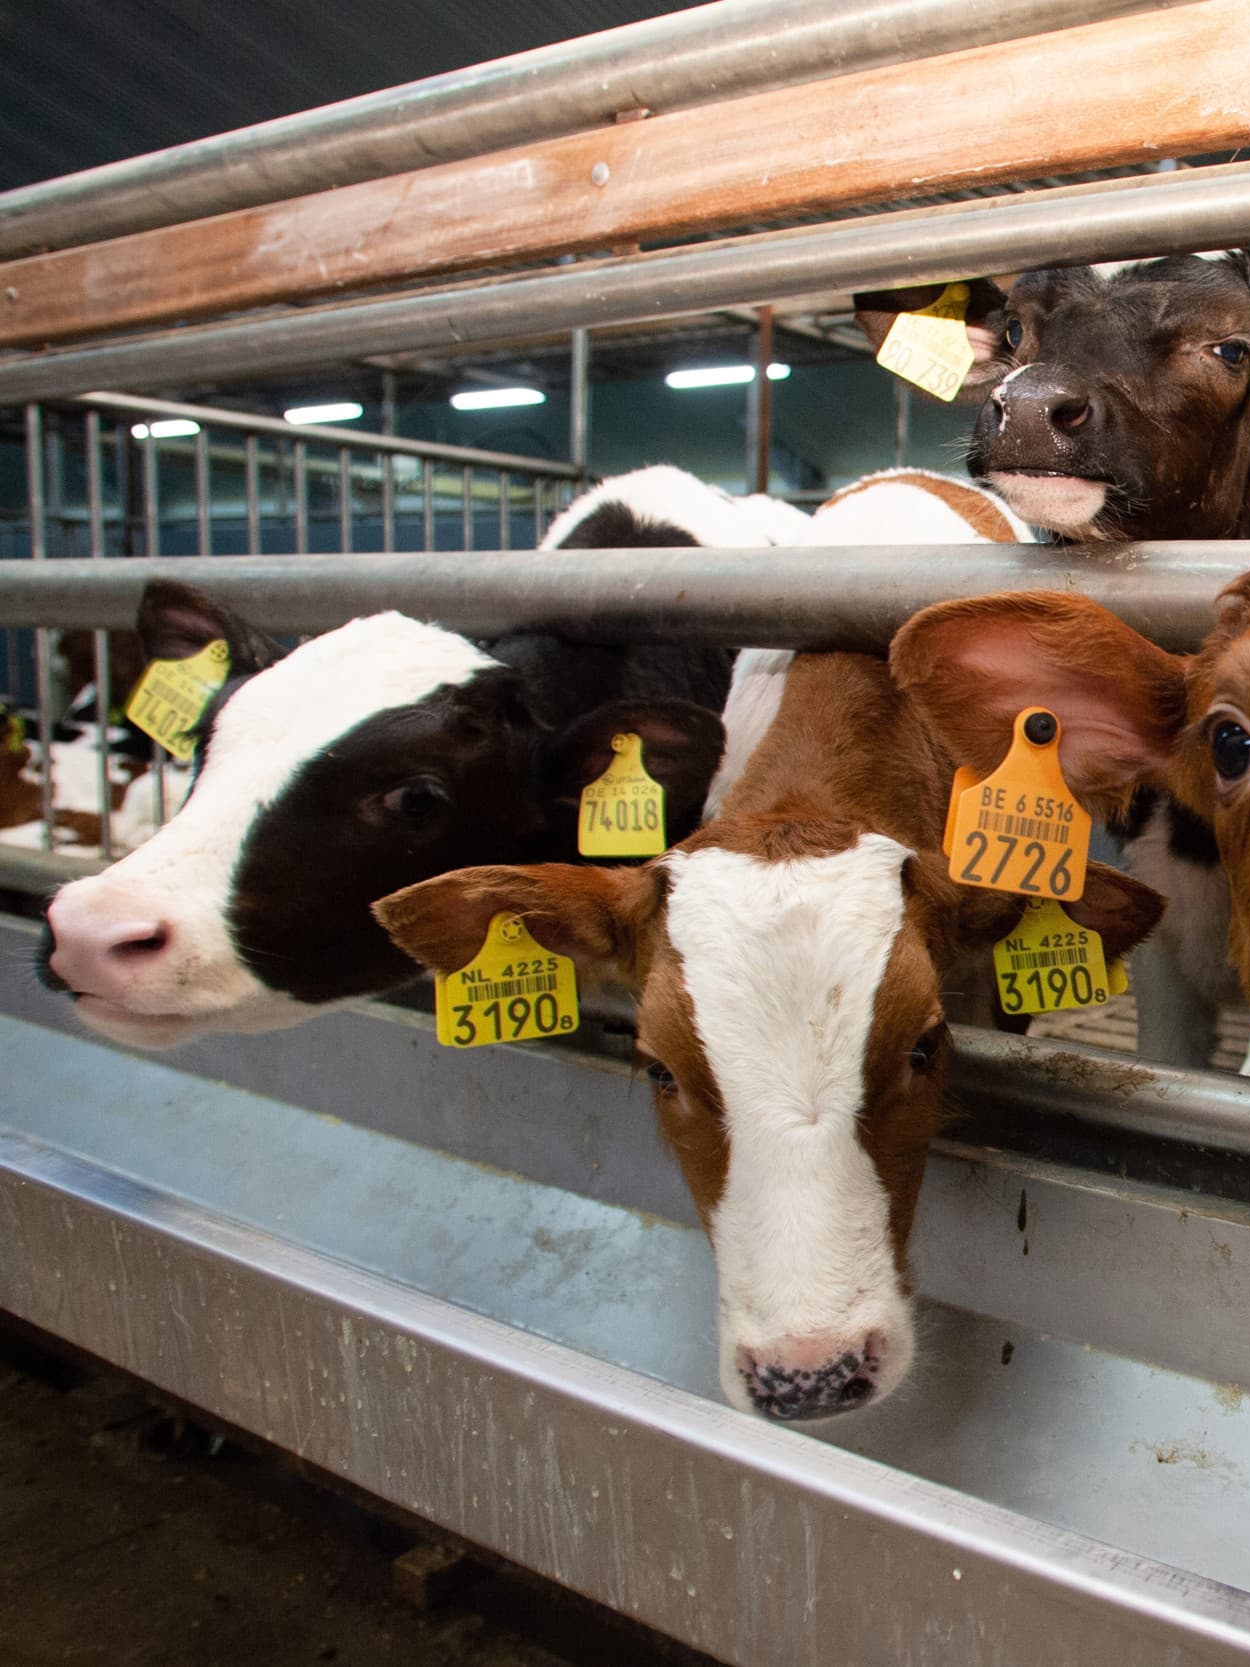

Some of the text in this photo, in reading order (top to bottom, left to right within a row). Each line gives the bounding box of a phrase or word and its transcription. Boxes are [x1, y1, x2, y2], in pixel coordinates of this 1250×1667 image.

[917, 355, 959, 395] 739
[585, 787, 605, 798] DE
[631, 784, 658, 796] 026
[981, 785, 1074, 823] BE 6 5516
[585, 798, 658, 833] 74018
[960, 830, 1073, 896] 2726
[1005, 931, 1089, 953] NL 4225
[461, 957, 559, 985] NL 4225
